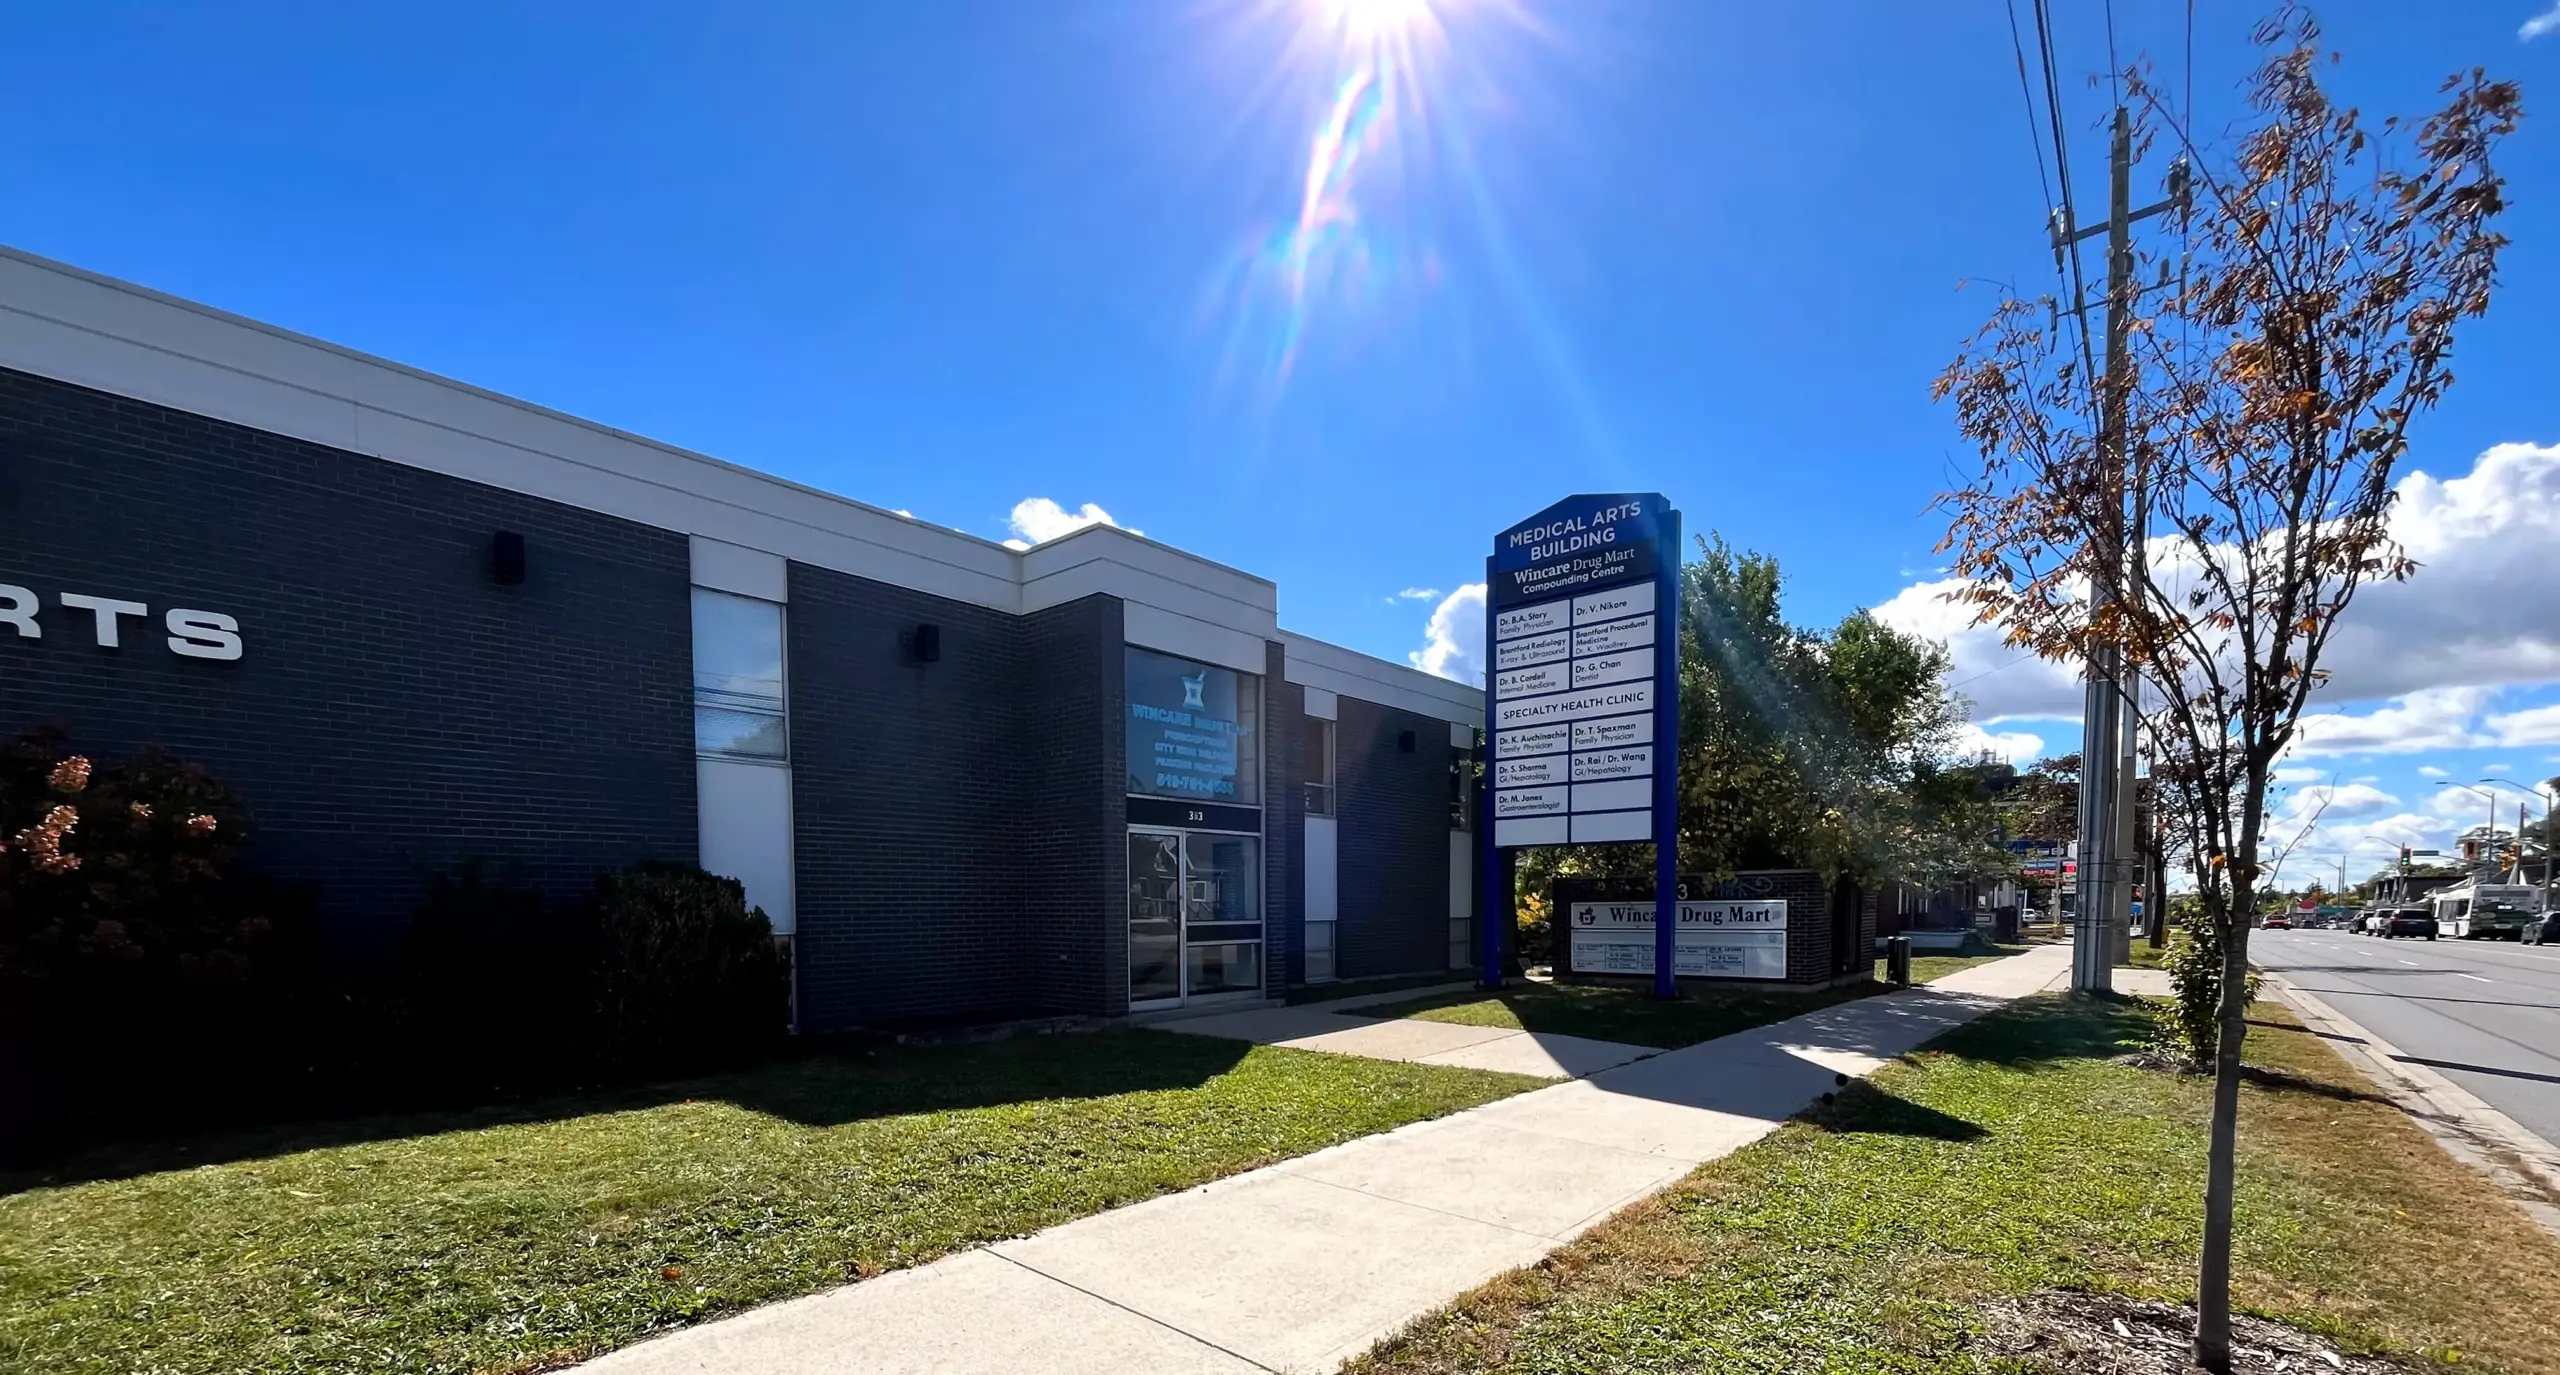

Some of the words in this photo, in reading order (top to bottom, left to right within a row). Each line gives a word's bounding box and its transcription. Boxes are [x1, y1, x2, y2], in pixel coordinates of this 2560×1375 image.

[1509, 517, 1587, 548] MEDICAL
[1592, 501, 1641, 527] ARTS
[1530, 527, 1616, 561] BUILDING
[1514, 563, 1571, 585] Wincare
[1573, 556, 1602, 572] Drug
[1604, 548, 1635, 565] Mart
[1522, 573, 1589, 594] Compounding
[1591, 565, 1625, 579] Centre
[1576, 607, 1588, 616] Dr.
[1589, 604, 1598, 613] V.
[1499, 618, 1511, 627] Dr.
[1511, 614, 1527, 625] B.A.
[1528, 612, 1548, 621] Story
[1500, 625, 1521, 635] Family
[1523, 619, 1554, 632] Physician
[1575, 626, 1609, 639] Brantford
[1610, 618, 1648, 632] Procedural
[1500, 644, 1530, 656] Brantford
[1531, 638, 1567, 650] Radiology
[1576, 636, 1609, 647] Medicine
[1500, 657, 1519, 665] X-ray
[1520, 652, 1527, 661] &
[1528, 647, 1566, 660] Ultrasound
[1575, 665, 1587, 674] Dr.
[1588, 662, 1598, 671] G.
[1599, 660, 1622, 670] Chan
[1499, 678, 1511, 686] Dr.
[1511, 676, 1519, 684] B.
[1575, 673, 1599, 683] Dentist
[1500, 684, 1524, 695] Internal
[1525, 680, 1557, 690] Medicine
[1503, 703, 1559, 720] SPECIALTY
[1560, 697, 1603, 712] HEALTH
[1606, 691, 1645, 706] CLINIC
[1575, 728, 1587, 737] Dr.
[1588, 726, 1596, 735] T.
[1597, 723, 1636, 735] Spaxman
[1499, 737, 1511, 745] Dr.
[1511, 735, 1519, 743] K.
[1575, 736, 1598, 745] Family
[1601, 733, 1634, 743] Physician
[1500, 744, 1521, 753] Family
[1523, 742, 1553, 752] Physician
[1574, 758, 1586, 766] Dr.
[1587, 756, 1601, 765] Rai
[1607, 754, 1620, 763] Dr.
[1621, 753, 1646, 762] Wang
[1499, 766, 1510, 774] Dr.
[1510, 765, 1518, 773] S.
[1518, 764, 1547, 772] Sharma
[1574, 765, 1632, 776] GI/Hepatology
[1499, 796, 1509, 804] Dr.
[1510, 795, 1520, 803] M.
[1521, 794, 1543, 802] Jones
[1609, 907, 1657, 923] Winca
[1681, 906, 1723, 925] Drug
[1728, 906, 1770, 923] Mart
